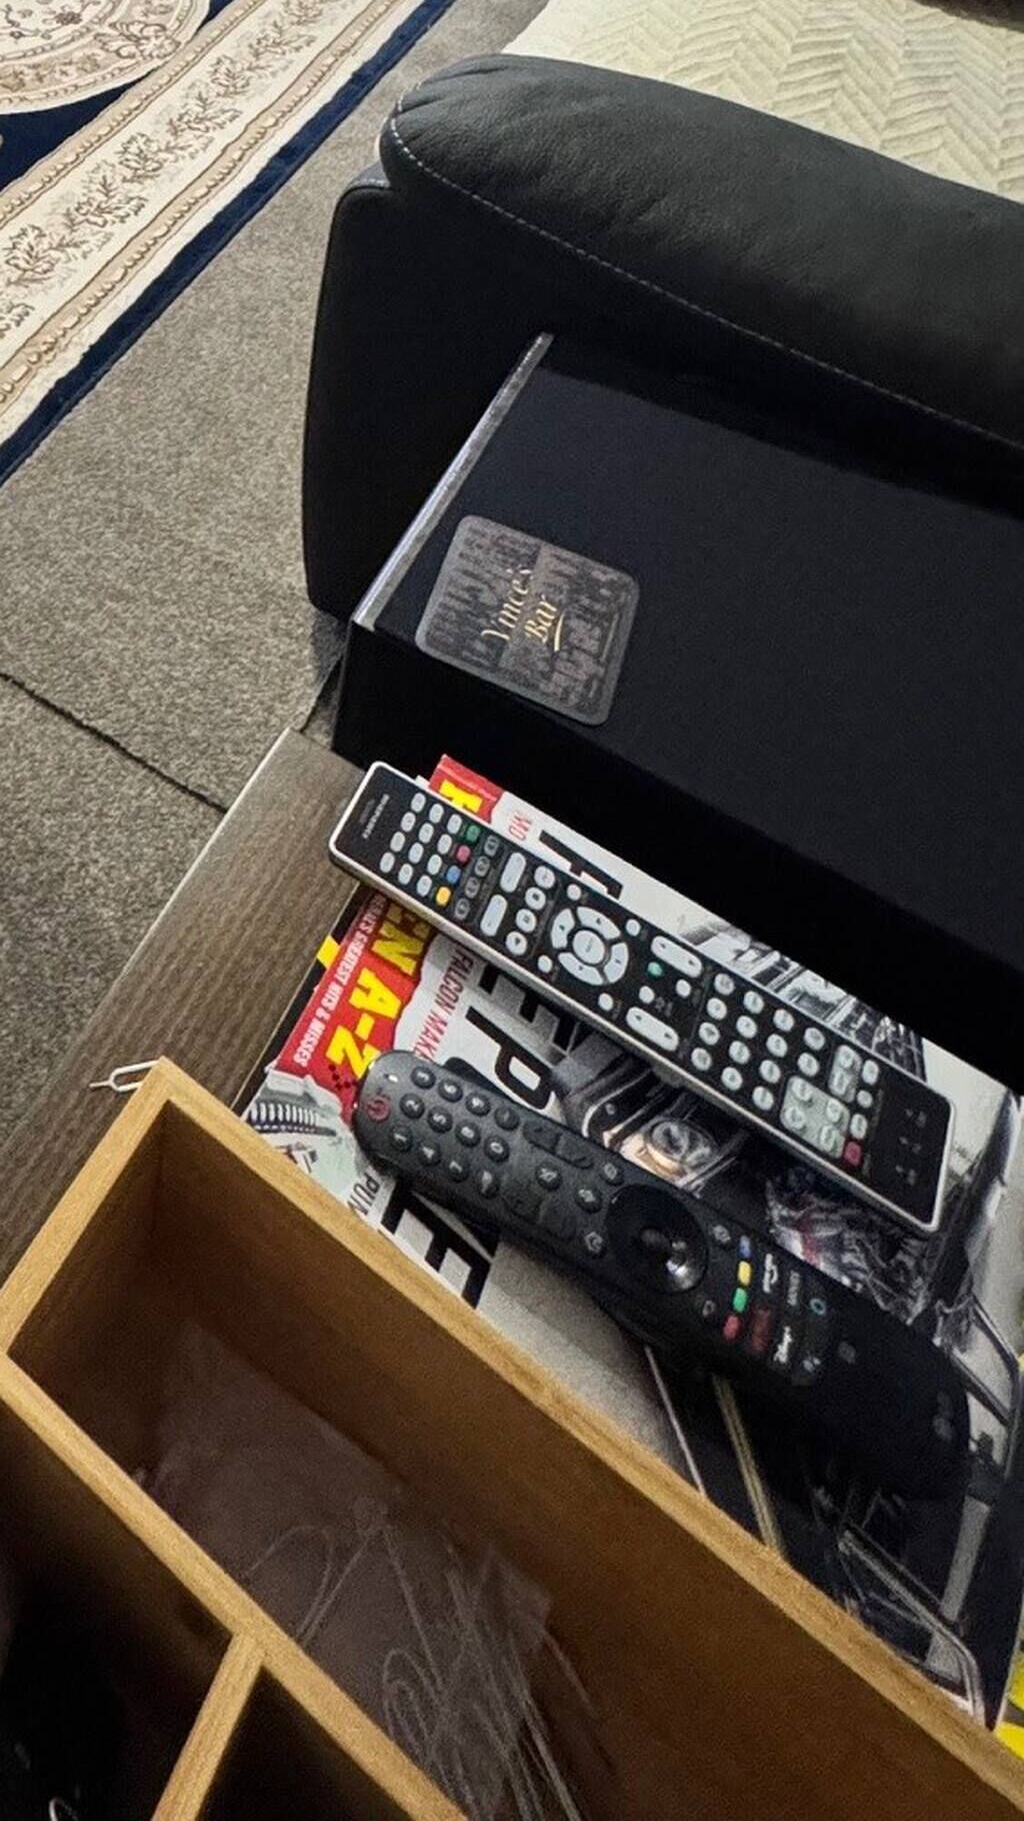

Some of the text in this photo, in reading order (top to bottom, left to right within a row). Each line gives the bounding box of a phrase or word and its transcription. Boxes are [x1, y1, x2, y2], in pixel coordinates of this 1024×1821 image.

[525, 594, 558, 644] Bar
[435, 948, 476, 1015] FALCON
[293, 1017, 326, 1067] MISSES
